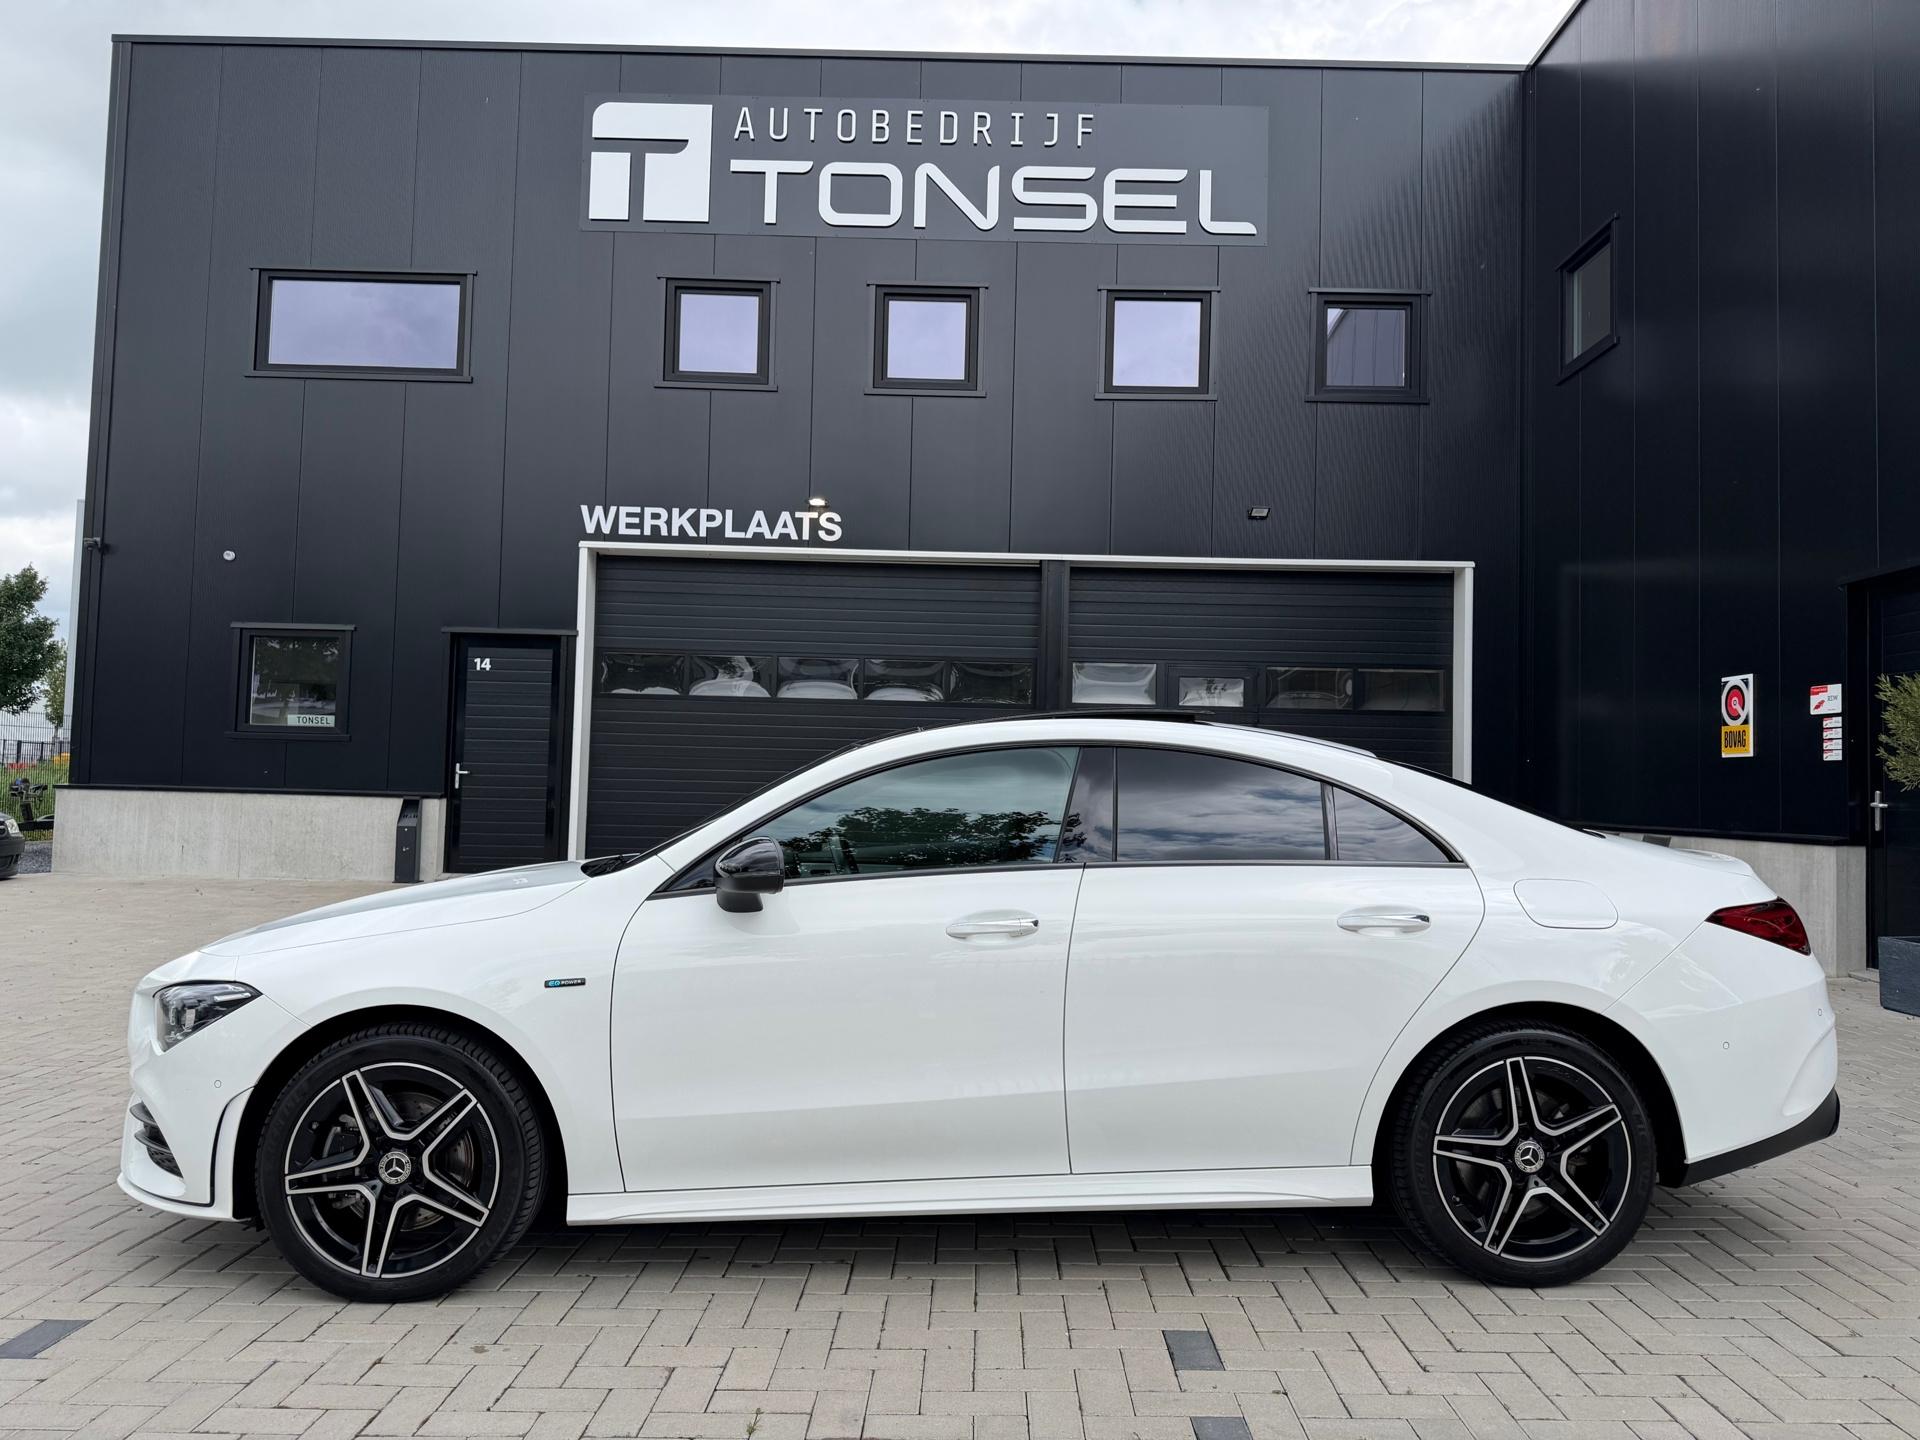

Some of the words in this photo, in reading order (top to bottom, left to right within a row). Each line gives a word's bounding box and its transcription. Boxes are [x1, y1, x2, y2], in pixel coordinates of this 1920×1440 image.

[733, 106, 1095, 147] AUTOBEDRIJF
[730, 158, 1258, 235] TONSEL
[579, 504, 843, 542] WERKPLAATS
[473, 657, 492, 671] 14
[296, 716, 331, 725] TONSEL
[1724, 730, 1746, 748] BOVAG
